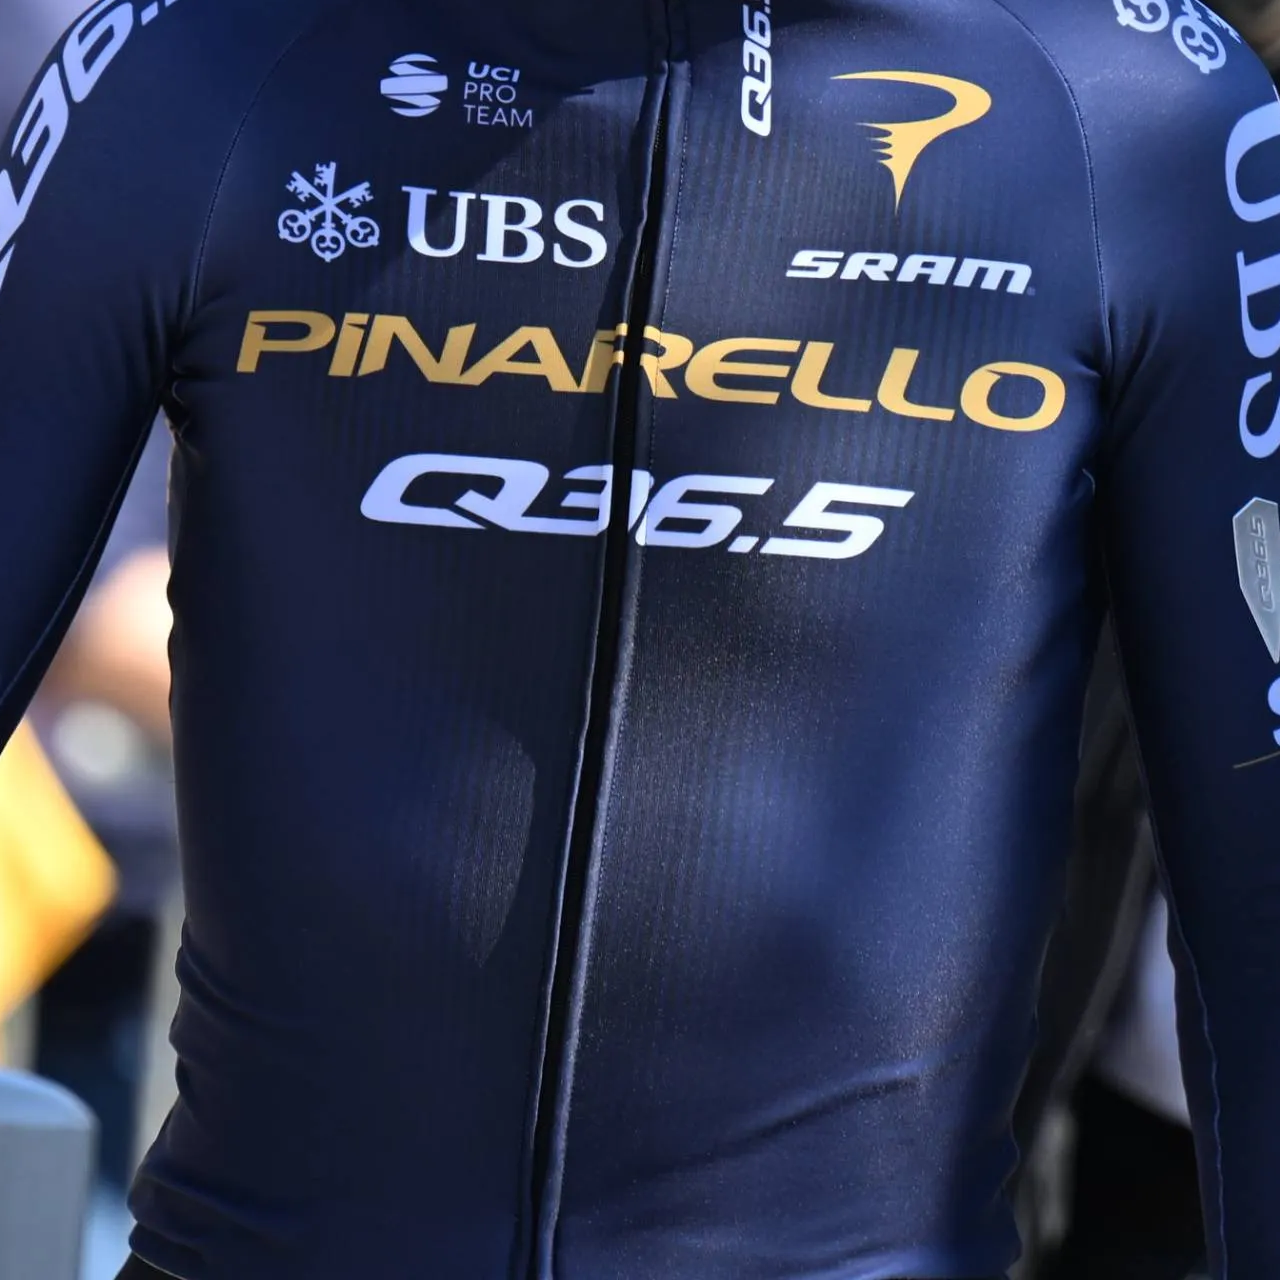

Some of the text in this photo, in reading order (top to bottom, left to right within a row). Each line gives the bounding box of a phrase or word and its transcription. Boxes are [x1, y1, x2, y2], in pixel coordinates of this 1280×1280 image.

[467, 61, 521, 83] UCI
[463, 81, 517, 104] PRO
[463, 104, 534, 129] TEAM
[401, 186, 608, 269] UBS
[785, 249, 1033, 295] SRAM
[360, 453, 916, 560] Q36.5
